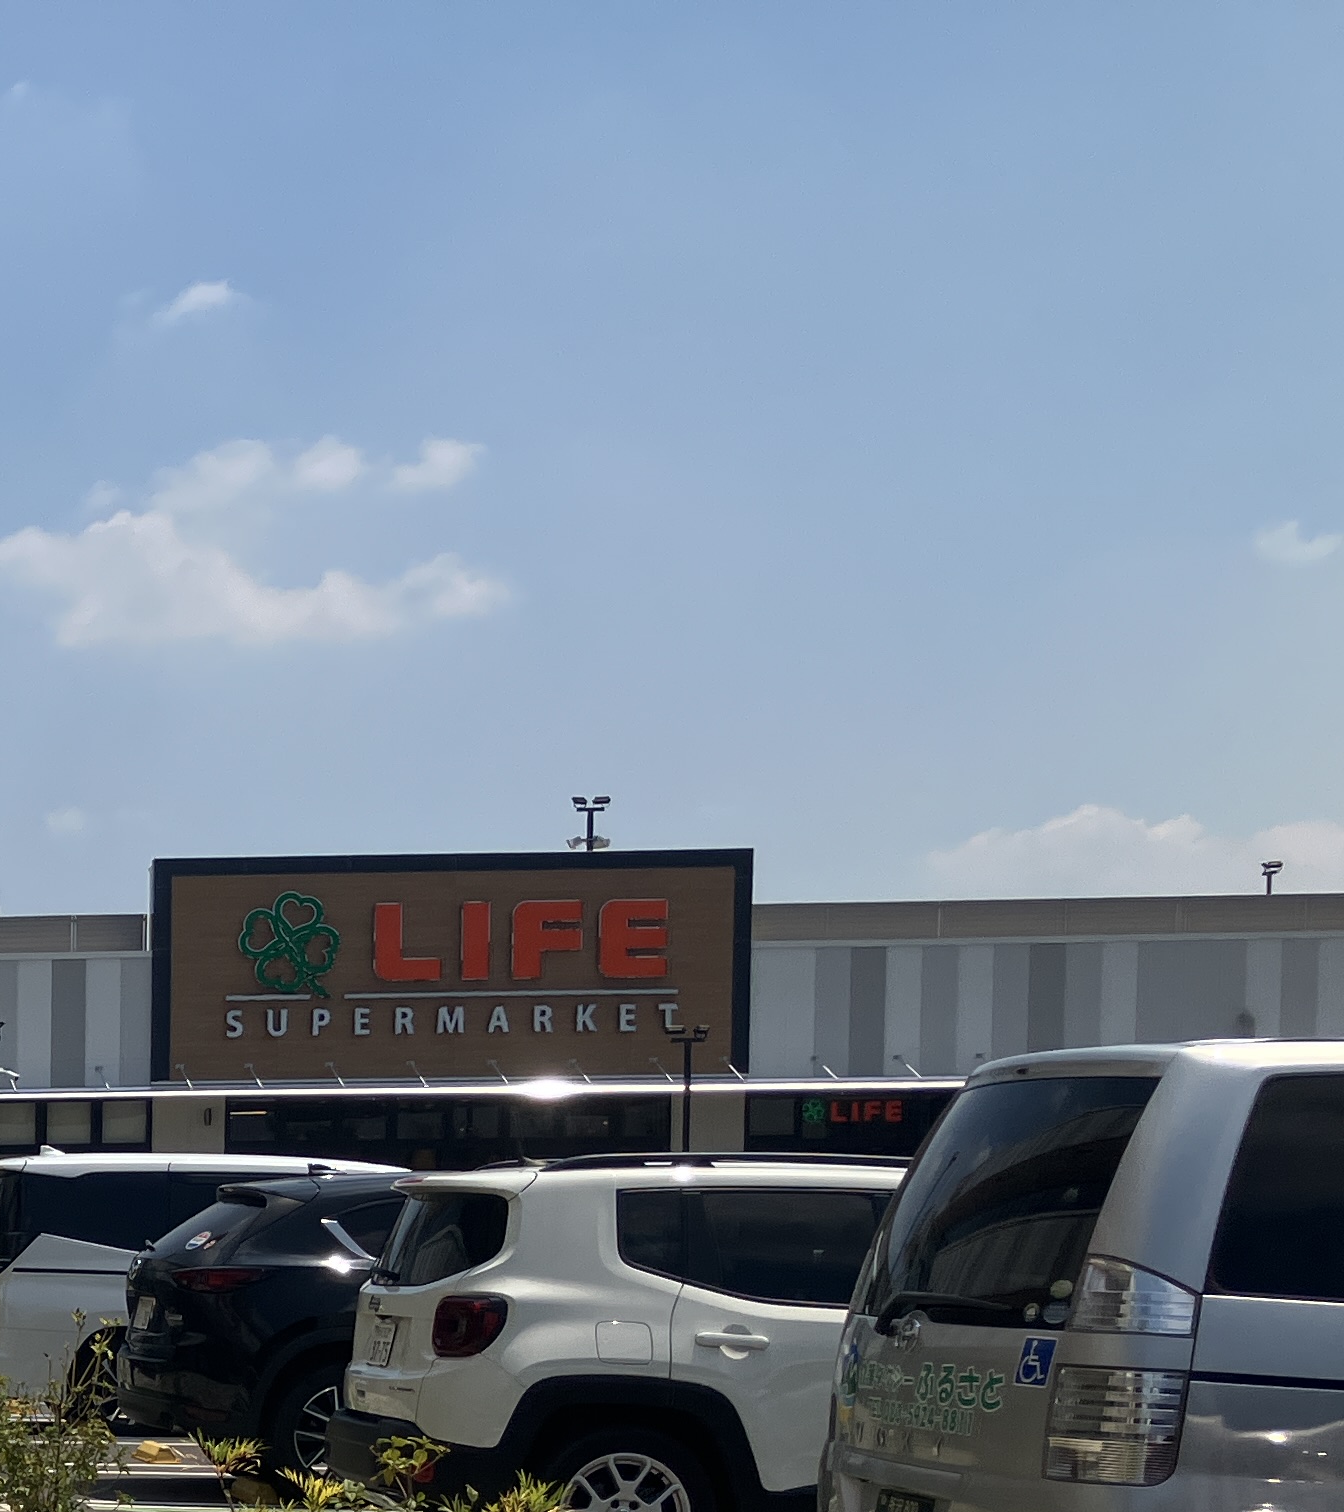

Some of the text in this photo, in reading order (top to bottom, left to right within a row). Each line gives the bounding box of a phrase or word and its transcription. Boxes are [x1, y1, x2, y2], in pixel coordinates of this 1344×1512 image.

[373, 898, 670, 981] LIFE
[225, 1002, 683, 1039] SUPERMARKET
[830, 1100, 904, 1123] LIFE
[916, 1362, 1006, 1412] ふるさと
